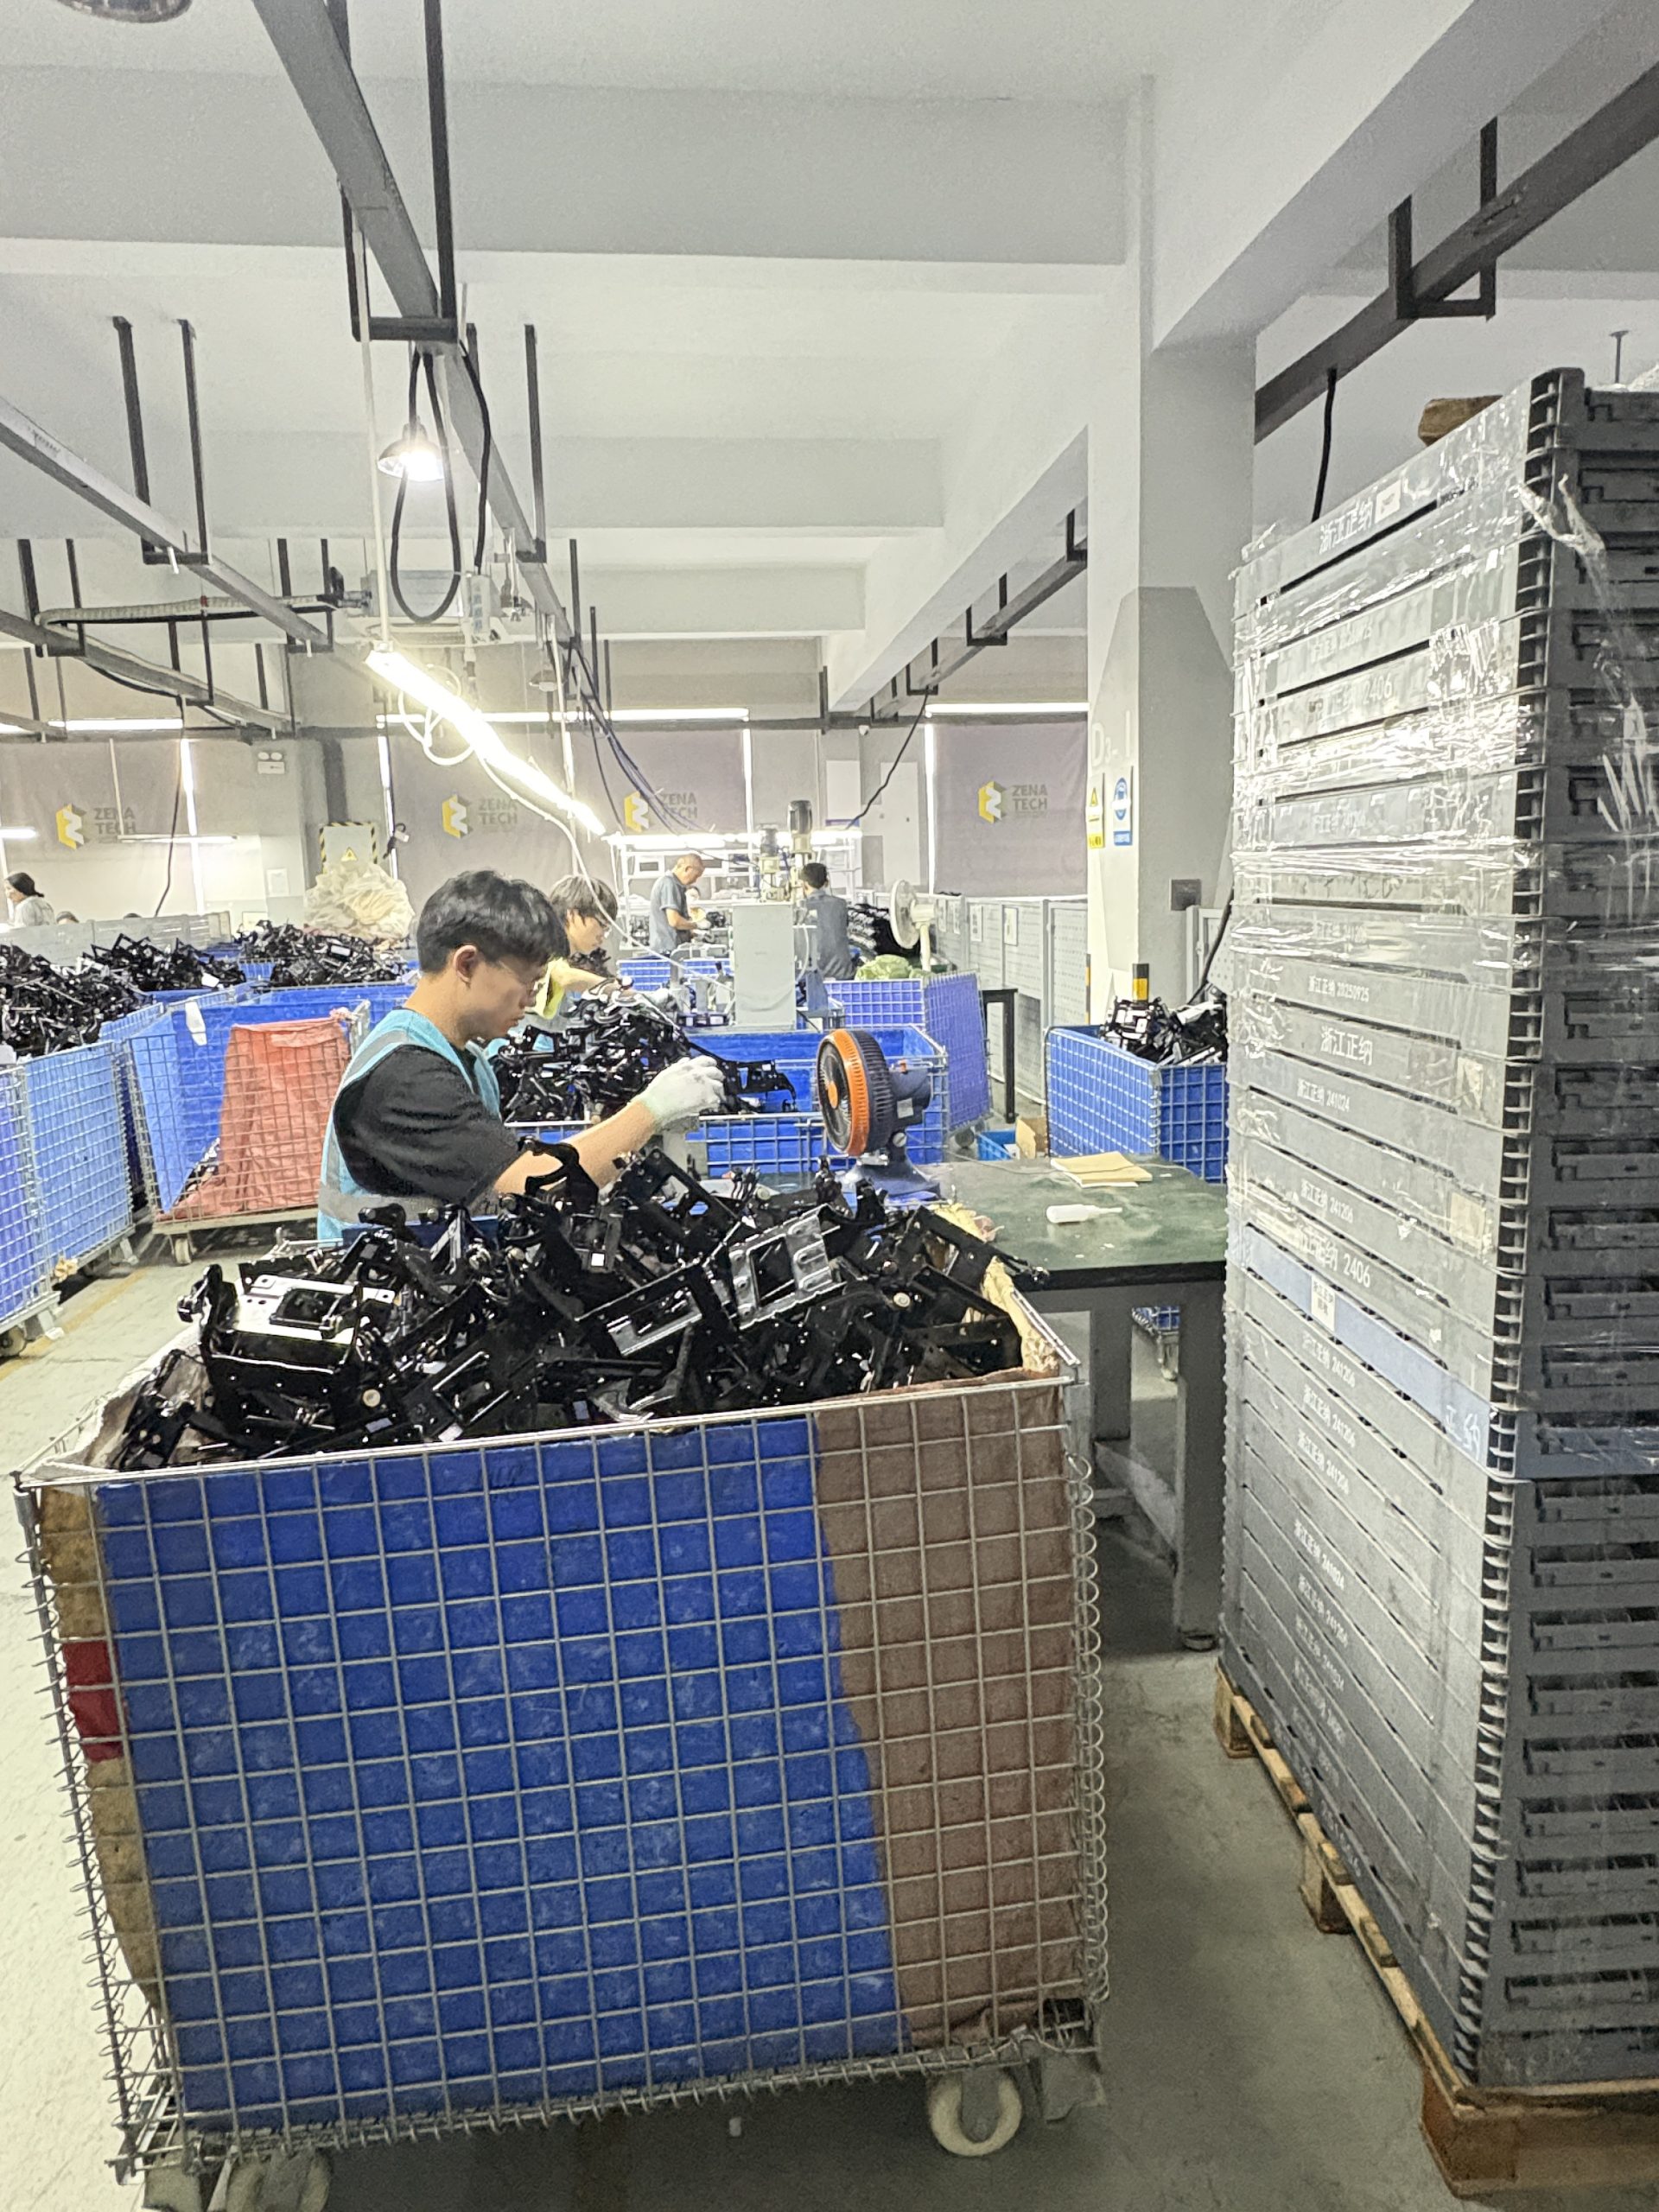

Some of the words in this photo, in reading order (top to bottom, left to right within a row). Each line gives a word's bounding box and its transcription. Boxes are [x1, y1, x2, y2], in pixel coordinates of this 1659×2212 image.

[1319, 497, 1373, 554] 浙江正纳
[1012, 785, 1048, 796] ZENA
[479, 798, 518, 810] ZENA
[1012, 798, 1047, 810] TECH
[480, 812, 518, 825] TECH
[1320, 1026, 1373, 1066] 浙江正纳
[1344, 1253, 1370, 1288] 2406
